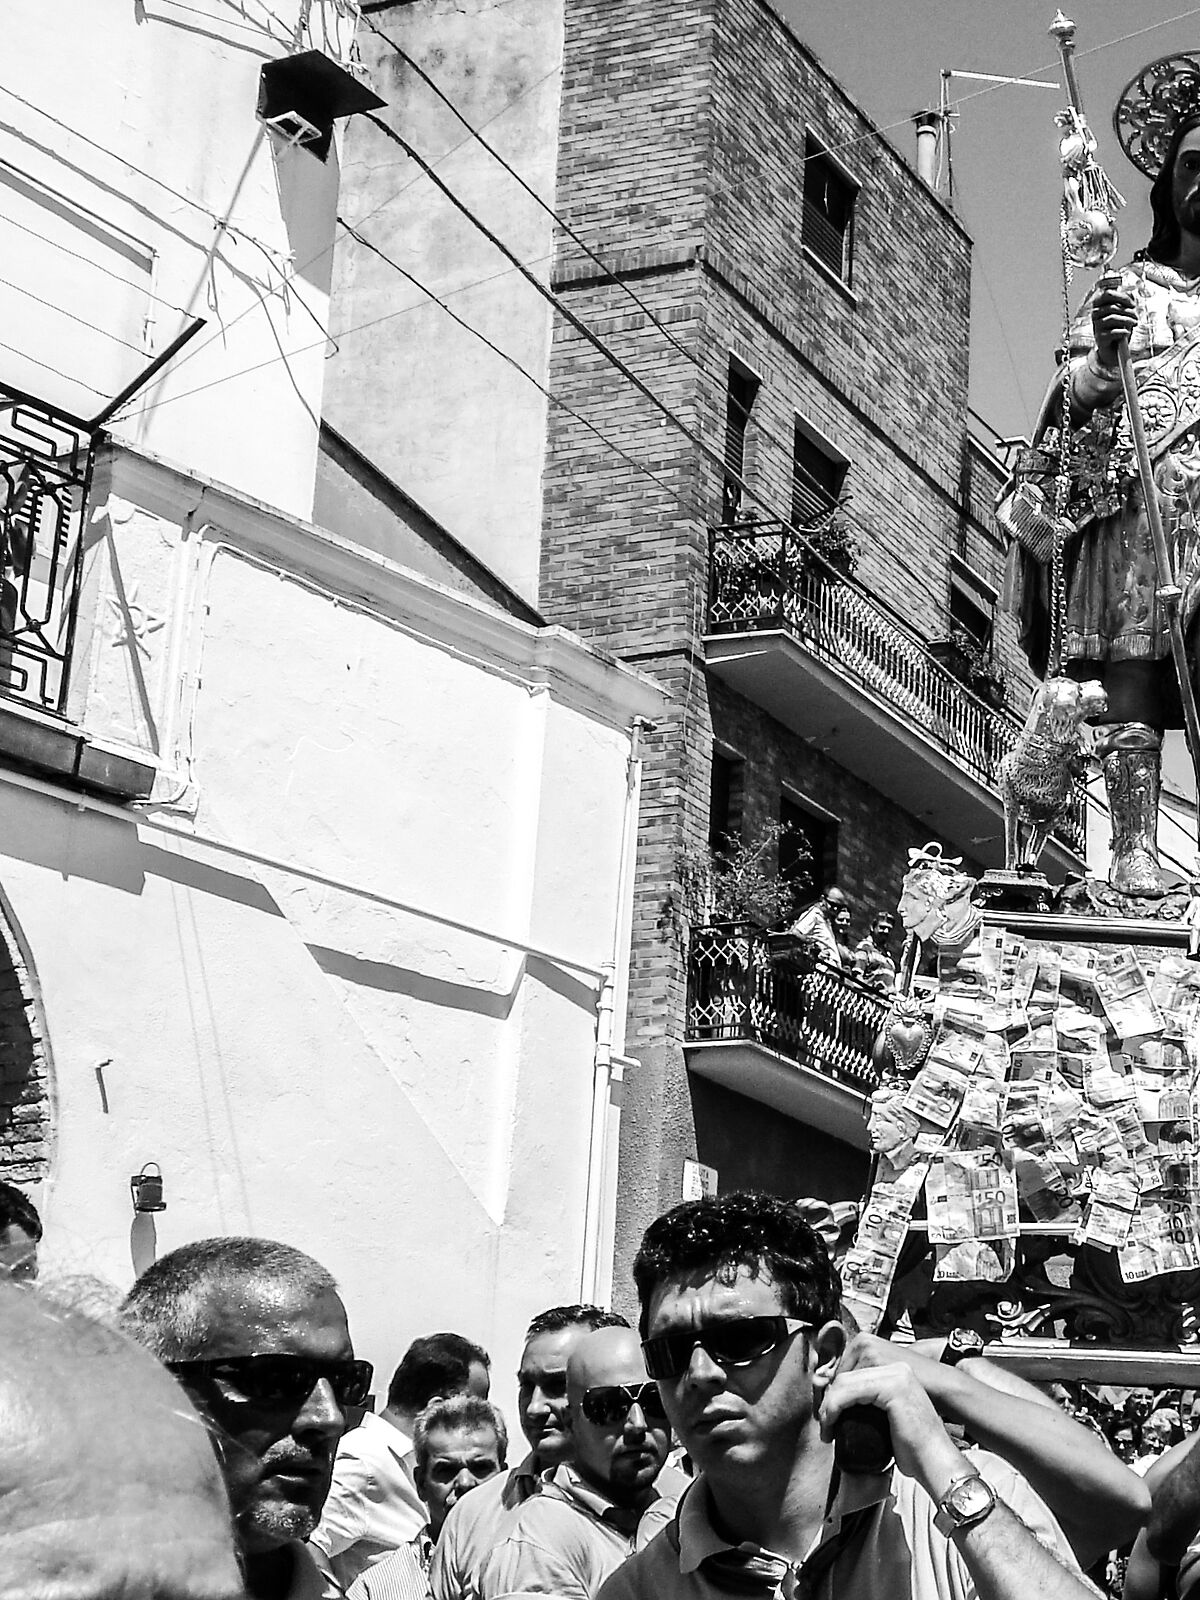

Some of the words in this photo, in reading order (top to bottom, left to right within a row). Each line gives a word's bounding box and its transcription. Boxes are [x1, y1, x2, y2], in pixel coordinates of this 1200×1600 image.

[985, 1190, 1006, 1204] 50
[1055, 1187, 1073, 1209] 20
[866, 1214, 882, 1230] 10
[1165, 1216, 1183, 1230] 10
[1170, 1230, 1186, 1244] 10
[843, 1261, 862, 1281] 50
[1125, 1271, 1135, 1280] 10
